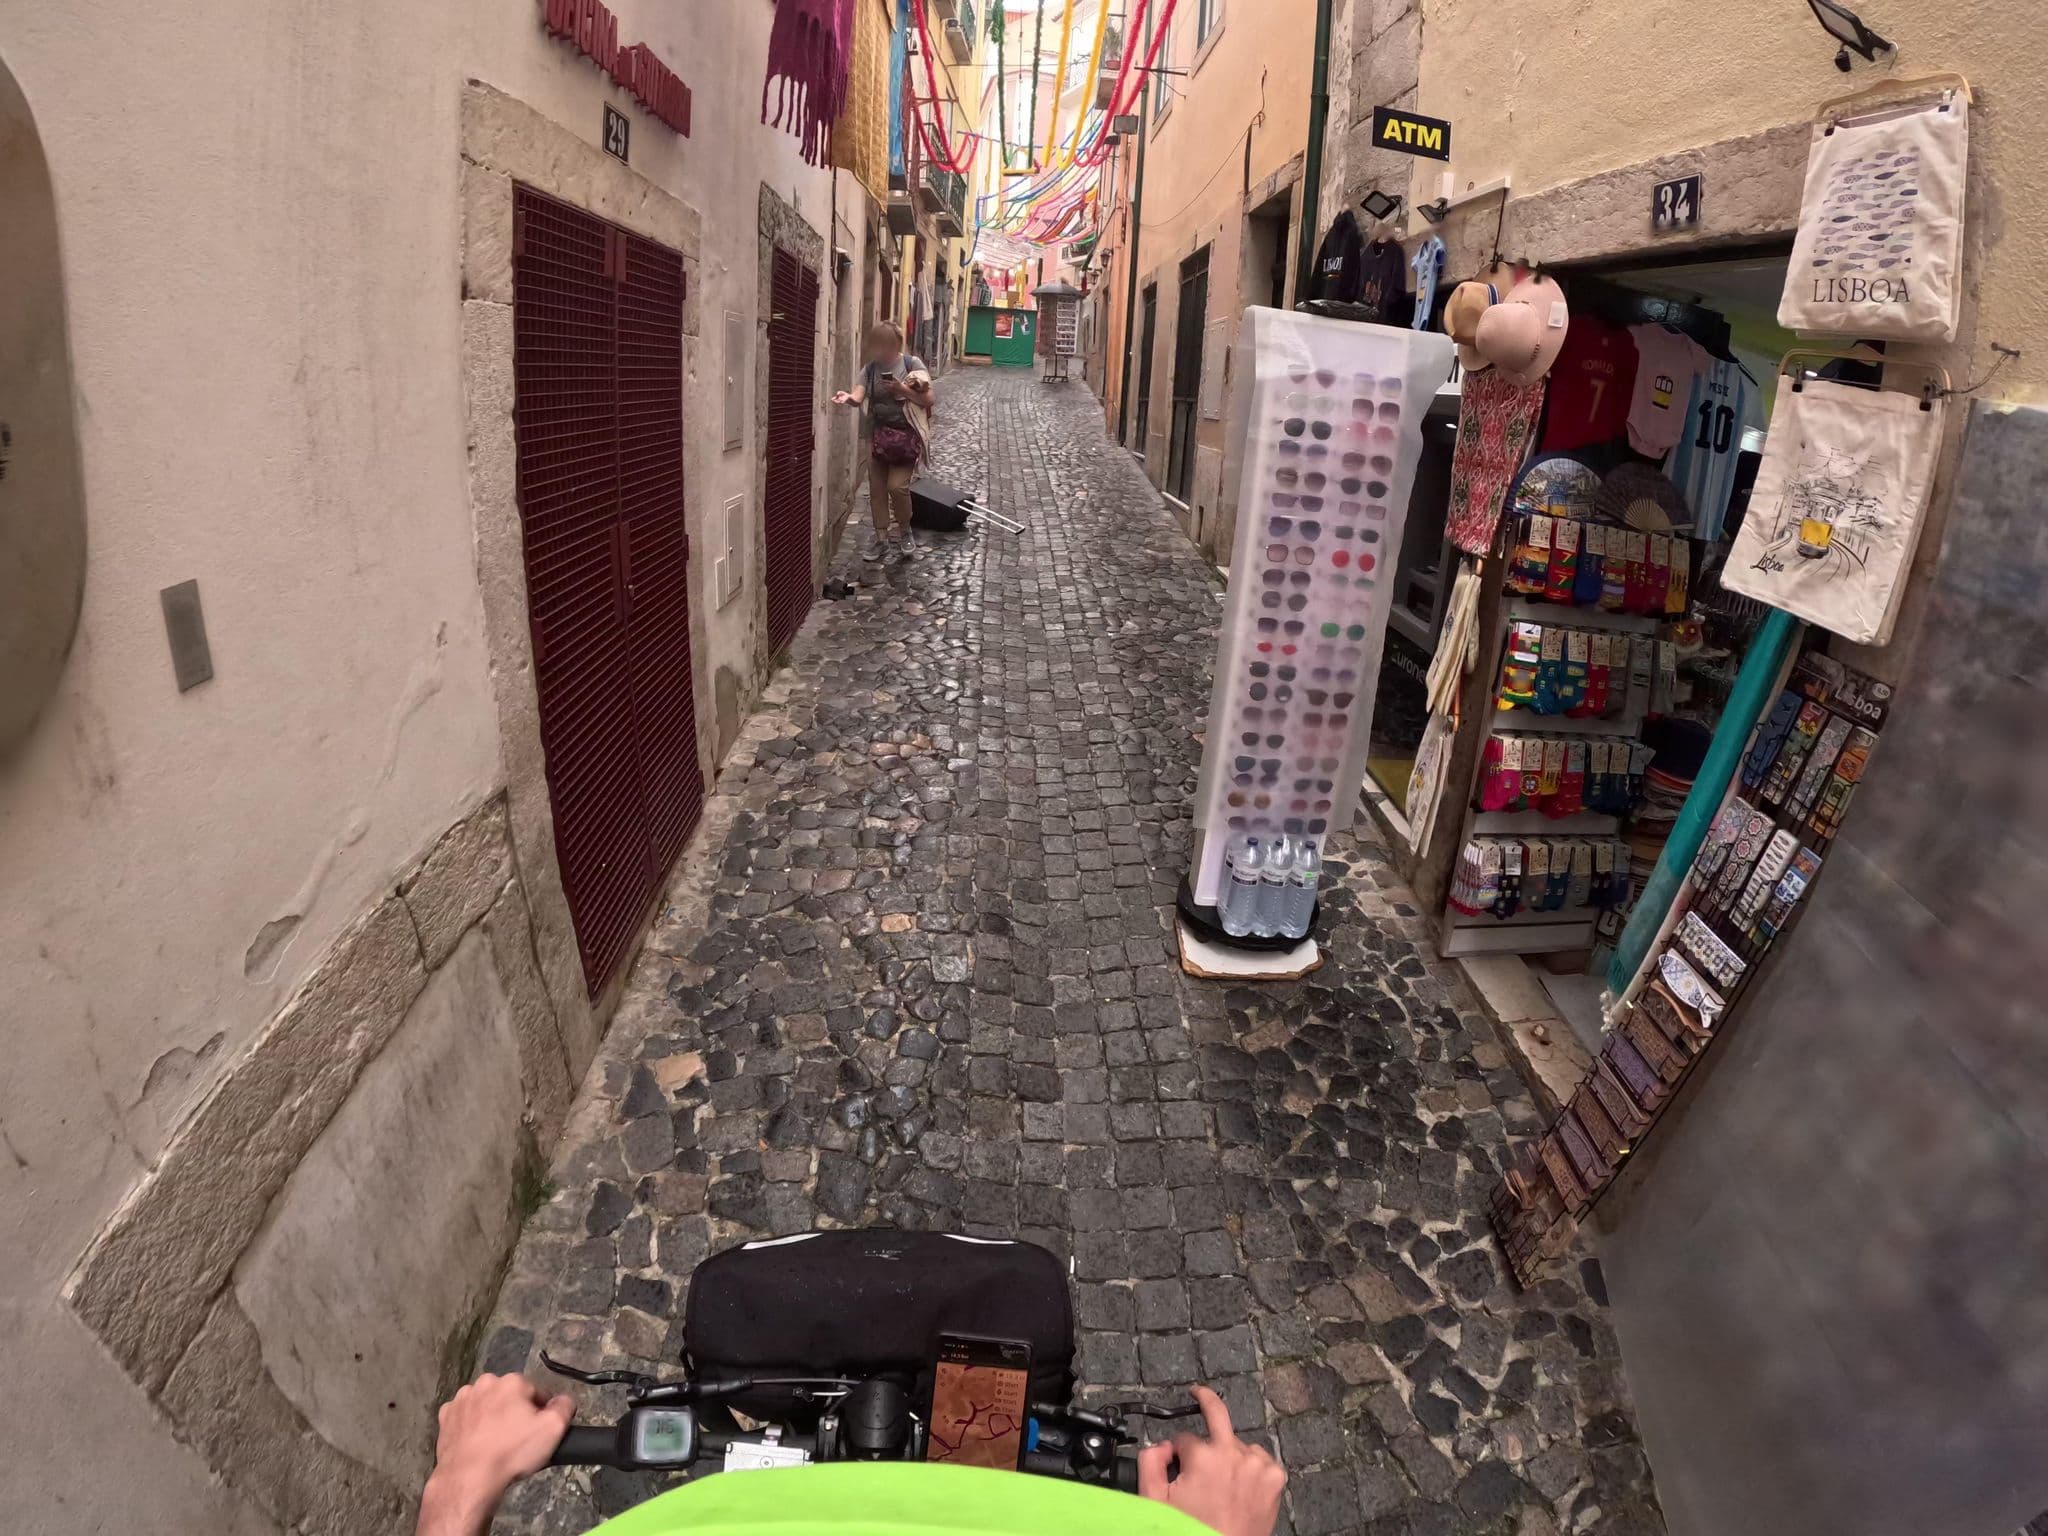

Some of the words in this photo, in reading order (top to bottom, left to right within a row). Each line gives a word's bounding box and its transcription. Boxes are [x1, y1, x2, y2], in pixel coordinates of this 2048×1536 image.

[608, 112, 625, 157] 29
[1382, 118, 1442, 151] ATM
[1658, 182, 1690, 226] 34
[1812, 277, 1911, 304] LISBOA
[1587, 378, 1608, 424] 7
[1695, 400, 1735, 454] 10
[1750, 551, 1785, 576] Lisboa
[1391, 643, 1426, 685] Eurone
